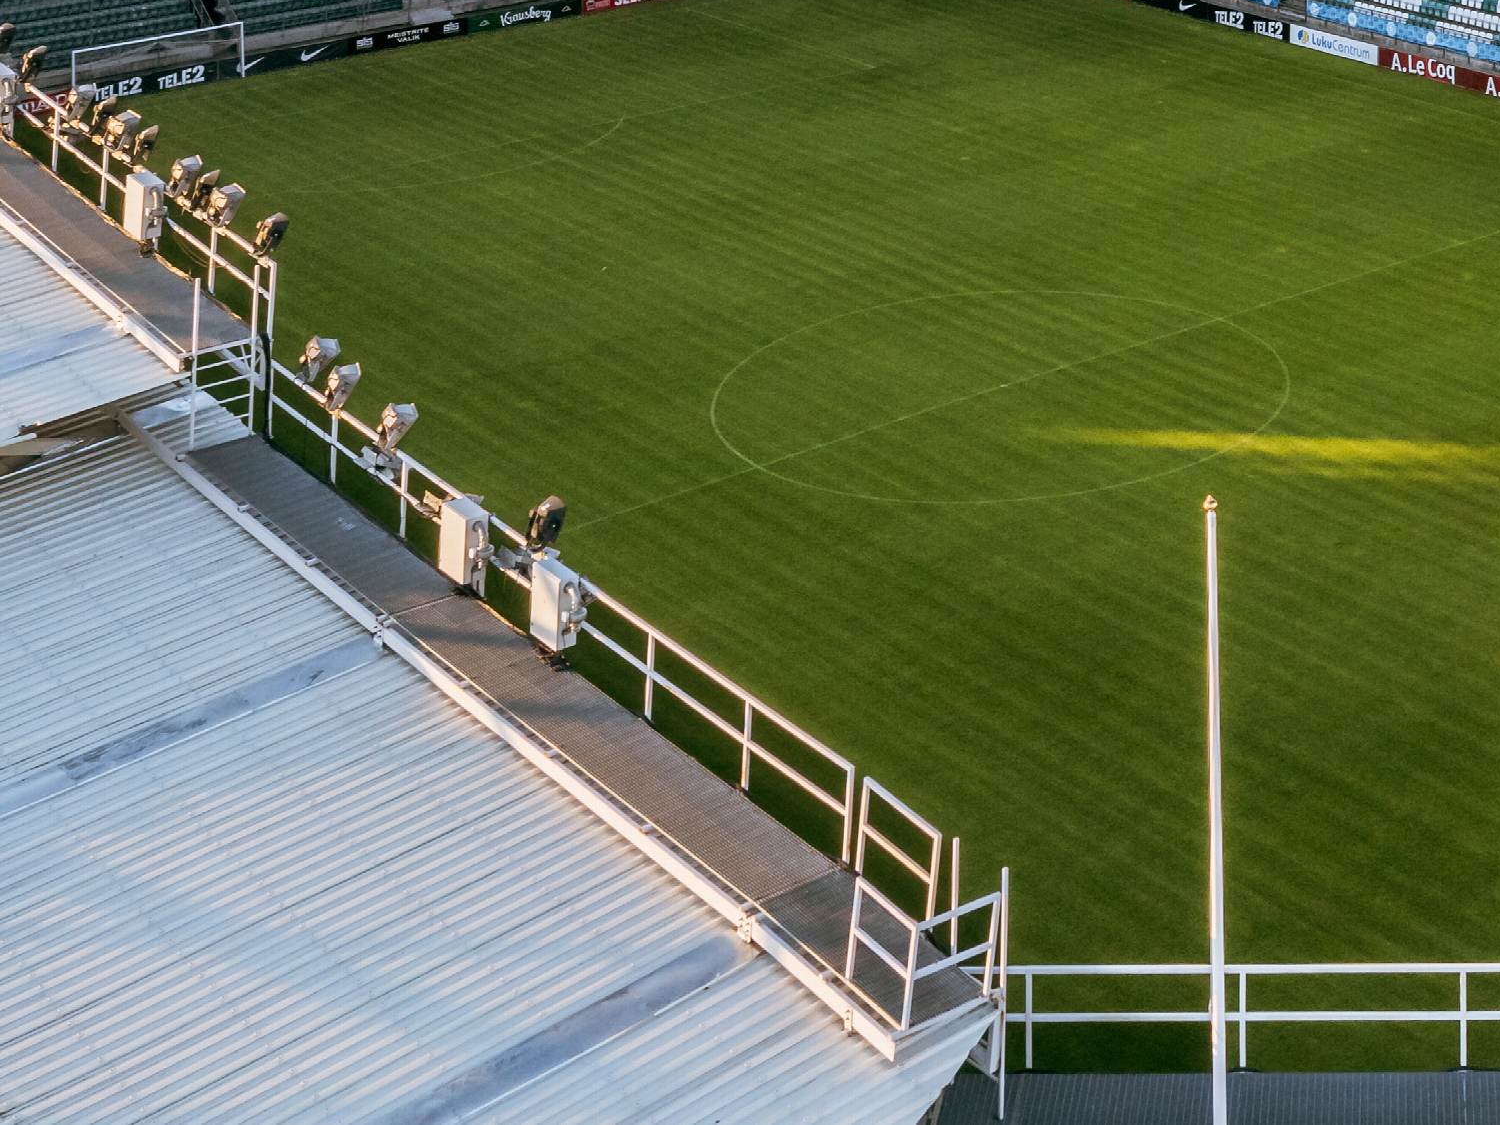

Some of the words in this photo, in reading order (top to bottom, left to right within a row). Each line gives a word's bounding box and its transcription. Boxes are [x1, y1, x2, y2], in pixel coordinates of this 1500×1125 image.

[500, 6, 551, 26] Krausberg
[1214, 10, 1244, 30] TELE2
[1253, 21, 1283, 40] TELE2
[1312, 33, 1370, 59] LukuCentrum
[157, 65, 205, 90] TELE2
[1427, 58, 1456, 85] Coq
